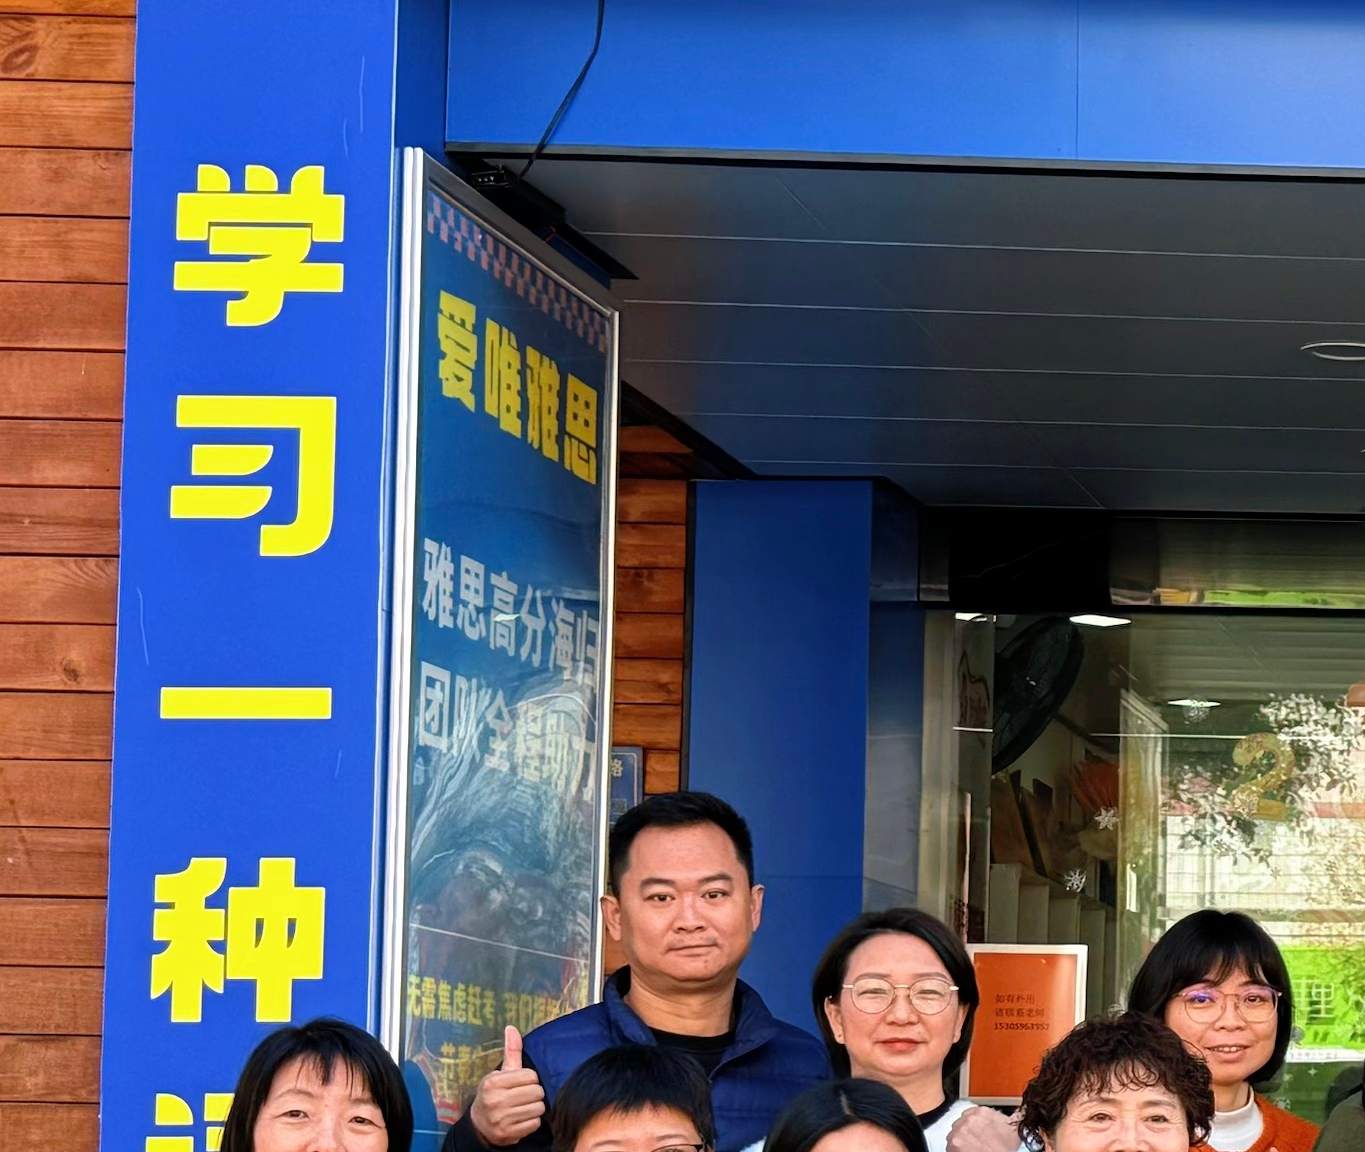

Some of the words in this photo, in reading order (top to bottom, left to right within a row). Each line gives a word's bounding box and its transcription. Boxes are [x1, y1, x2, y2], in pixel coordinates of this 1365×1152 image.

[438, 289, 598, 484] 爱唯雅思
[422, 537, 599, 692] 雅思高分海归
